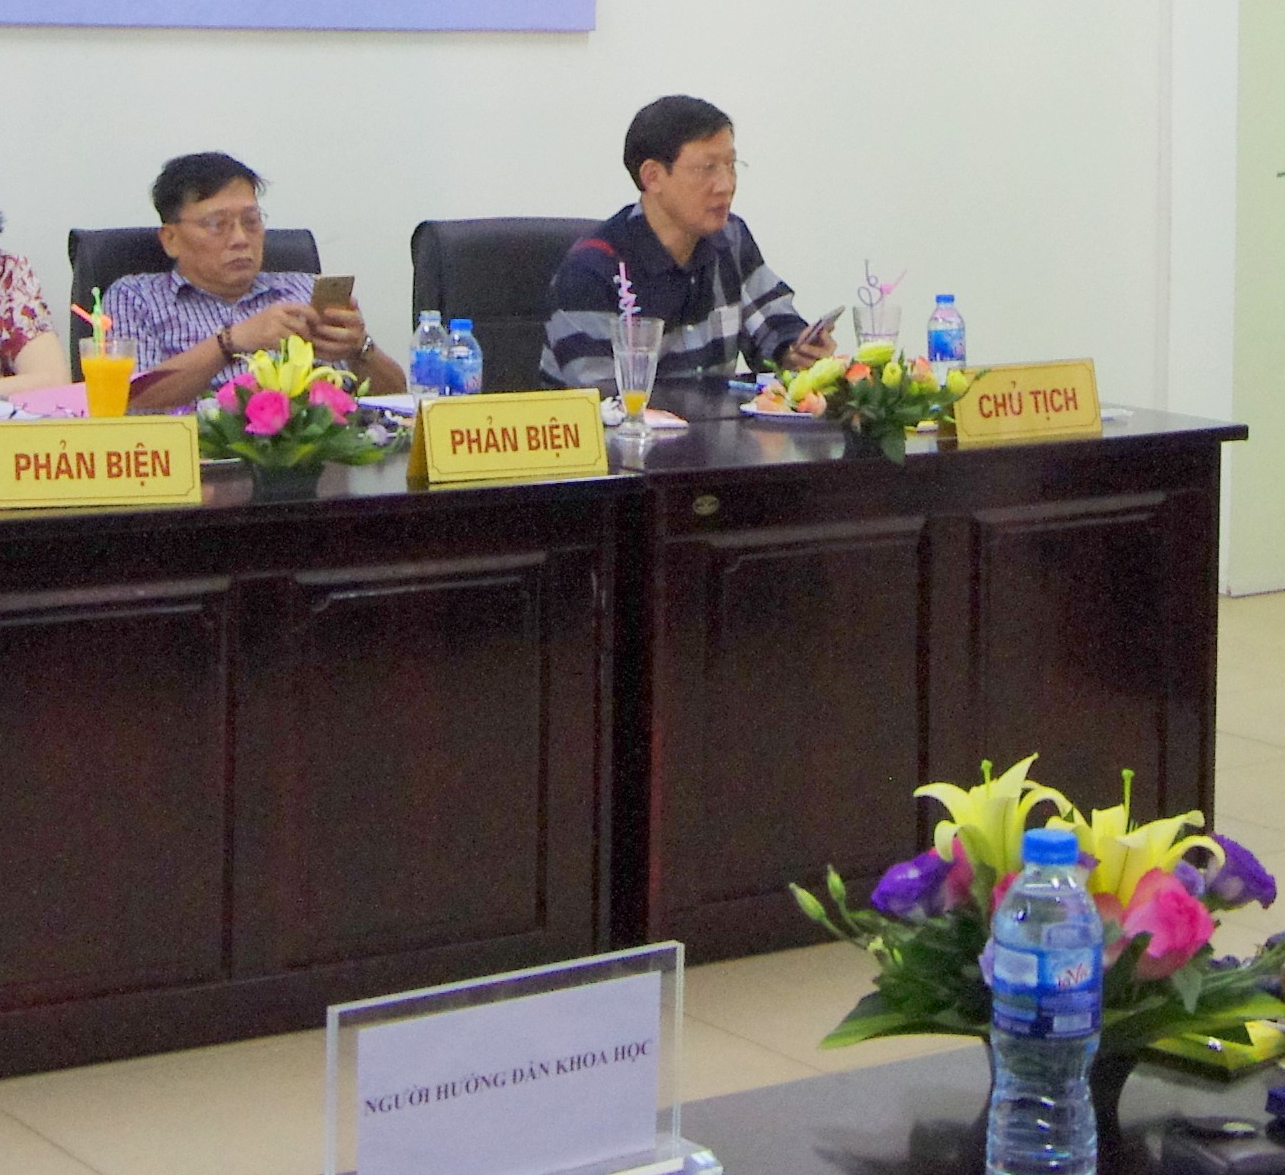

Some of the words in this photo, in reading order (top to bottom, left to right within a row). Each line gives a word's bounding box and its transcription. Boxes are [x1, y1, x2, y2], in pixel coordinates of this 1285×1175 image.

[978, 380, 1023, 419] CHỦ
[1029, 387, 1078, 421] TỊCH
[450, 415, 519, 455] PHẢN
[525, 416, 580, 458] BIỆN
[14, 440, 96, 481] PHẢN
[106, 442, 171, 487] BIỆN
[555, 1050, 608, 1075] KHOA
[613, 1039, 653, 1063] HỌC
